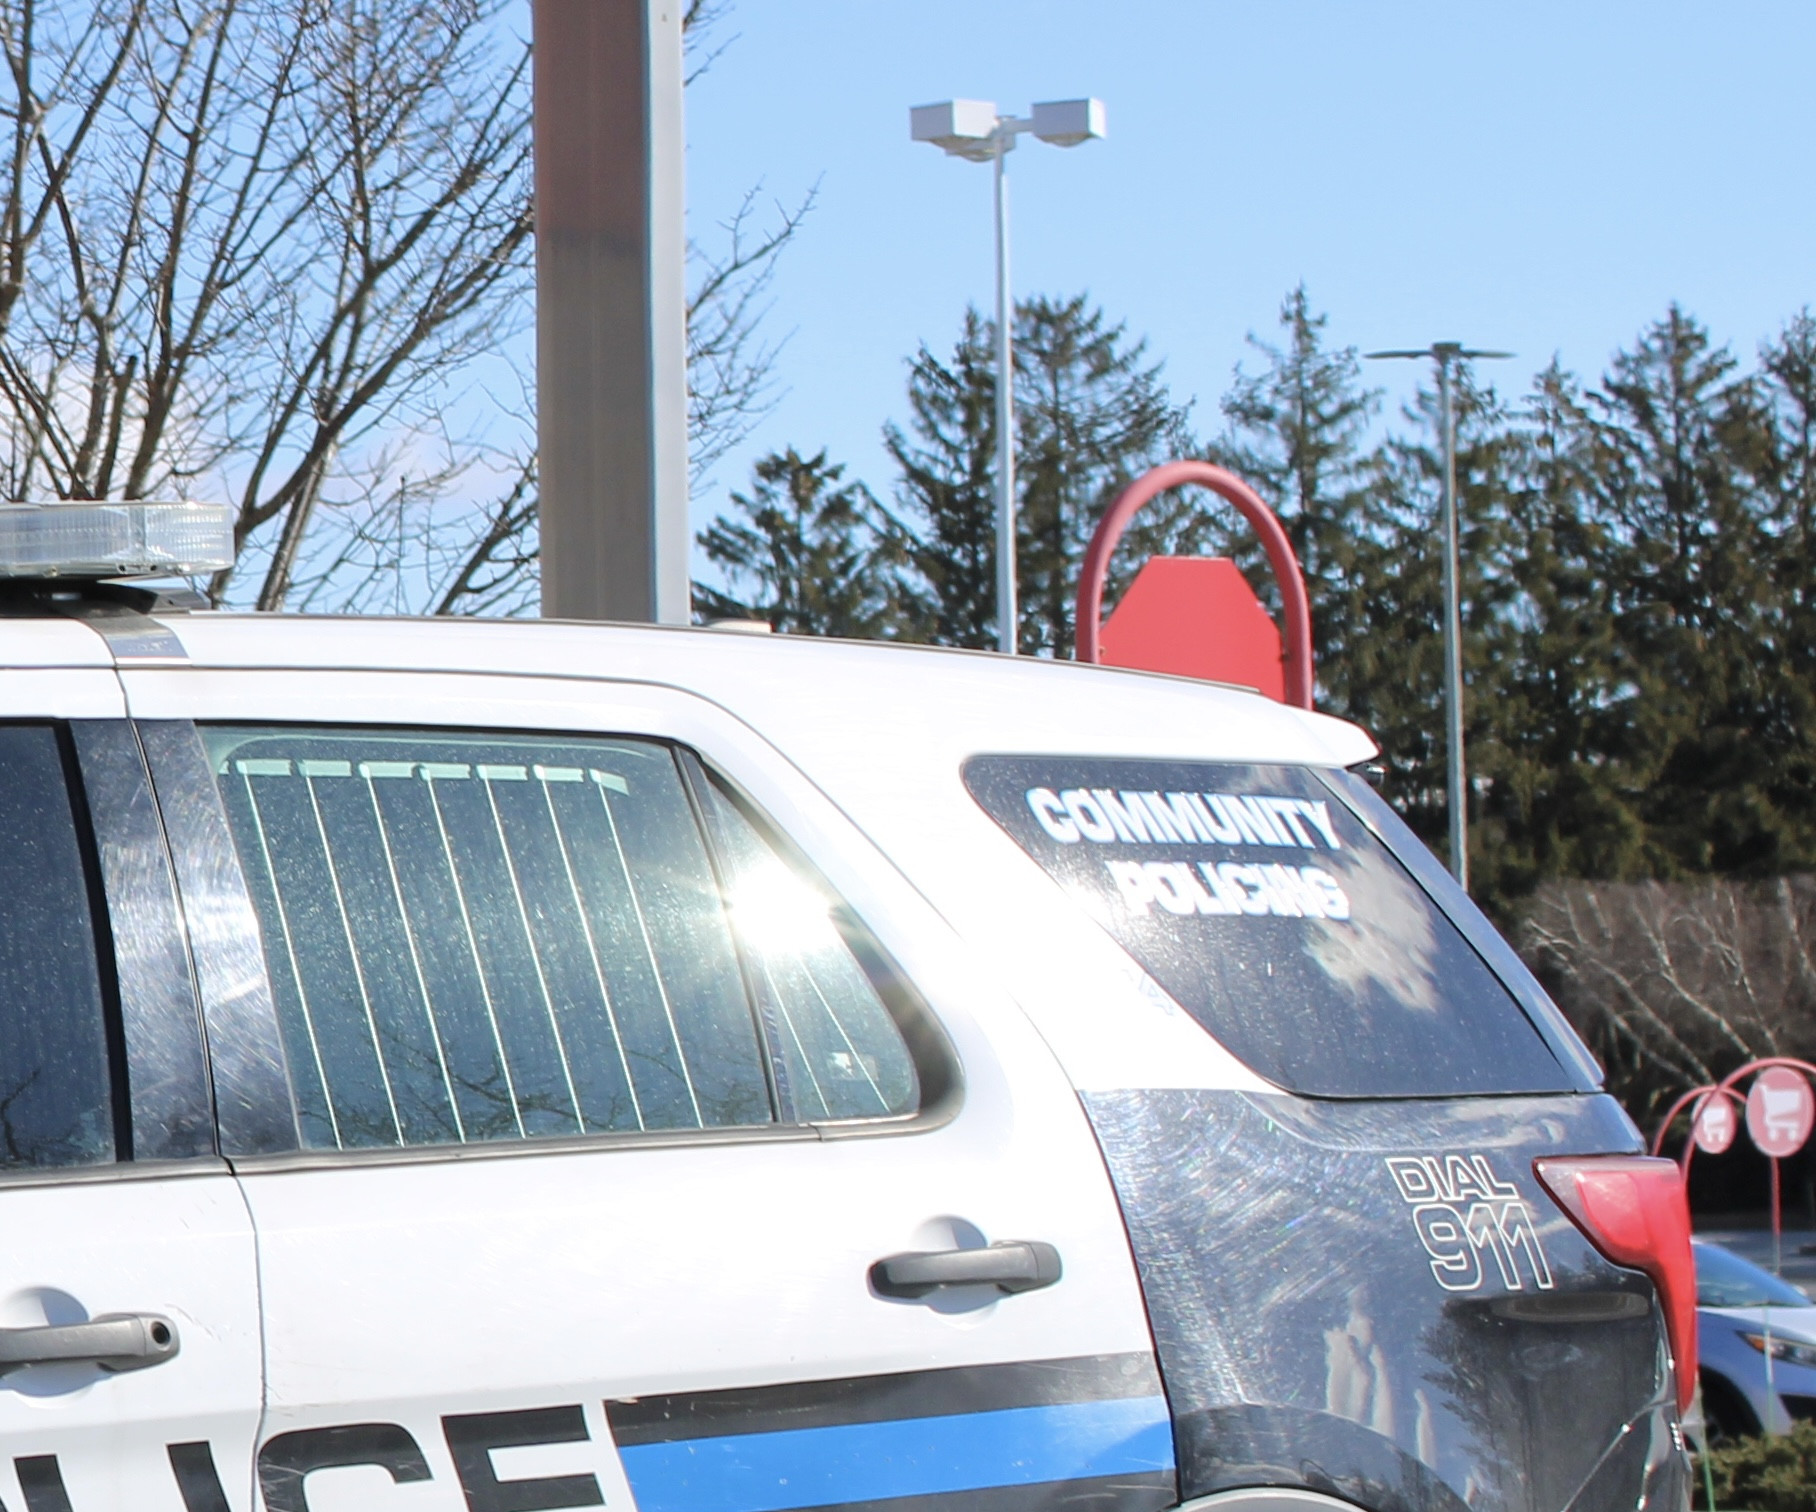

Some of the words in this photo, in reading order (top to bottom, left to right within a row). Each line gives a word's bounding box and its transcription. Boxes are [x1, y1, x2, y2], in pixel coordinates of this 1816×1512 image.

[1025, 787, 1341, 849] COMMUNITY
[1104, 860, 1350, 920] POLICING
[1384, 1155, 1519, 1202] DIAL
[1412, 1203, 1554, 1290] 911
